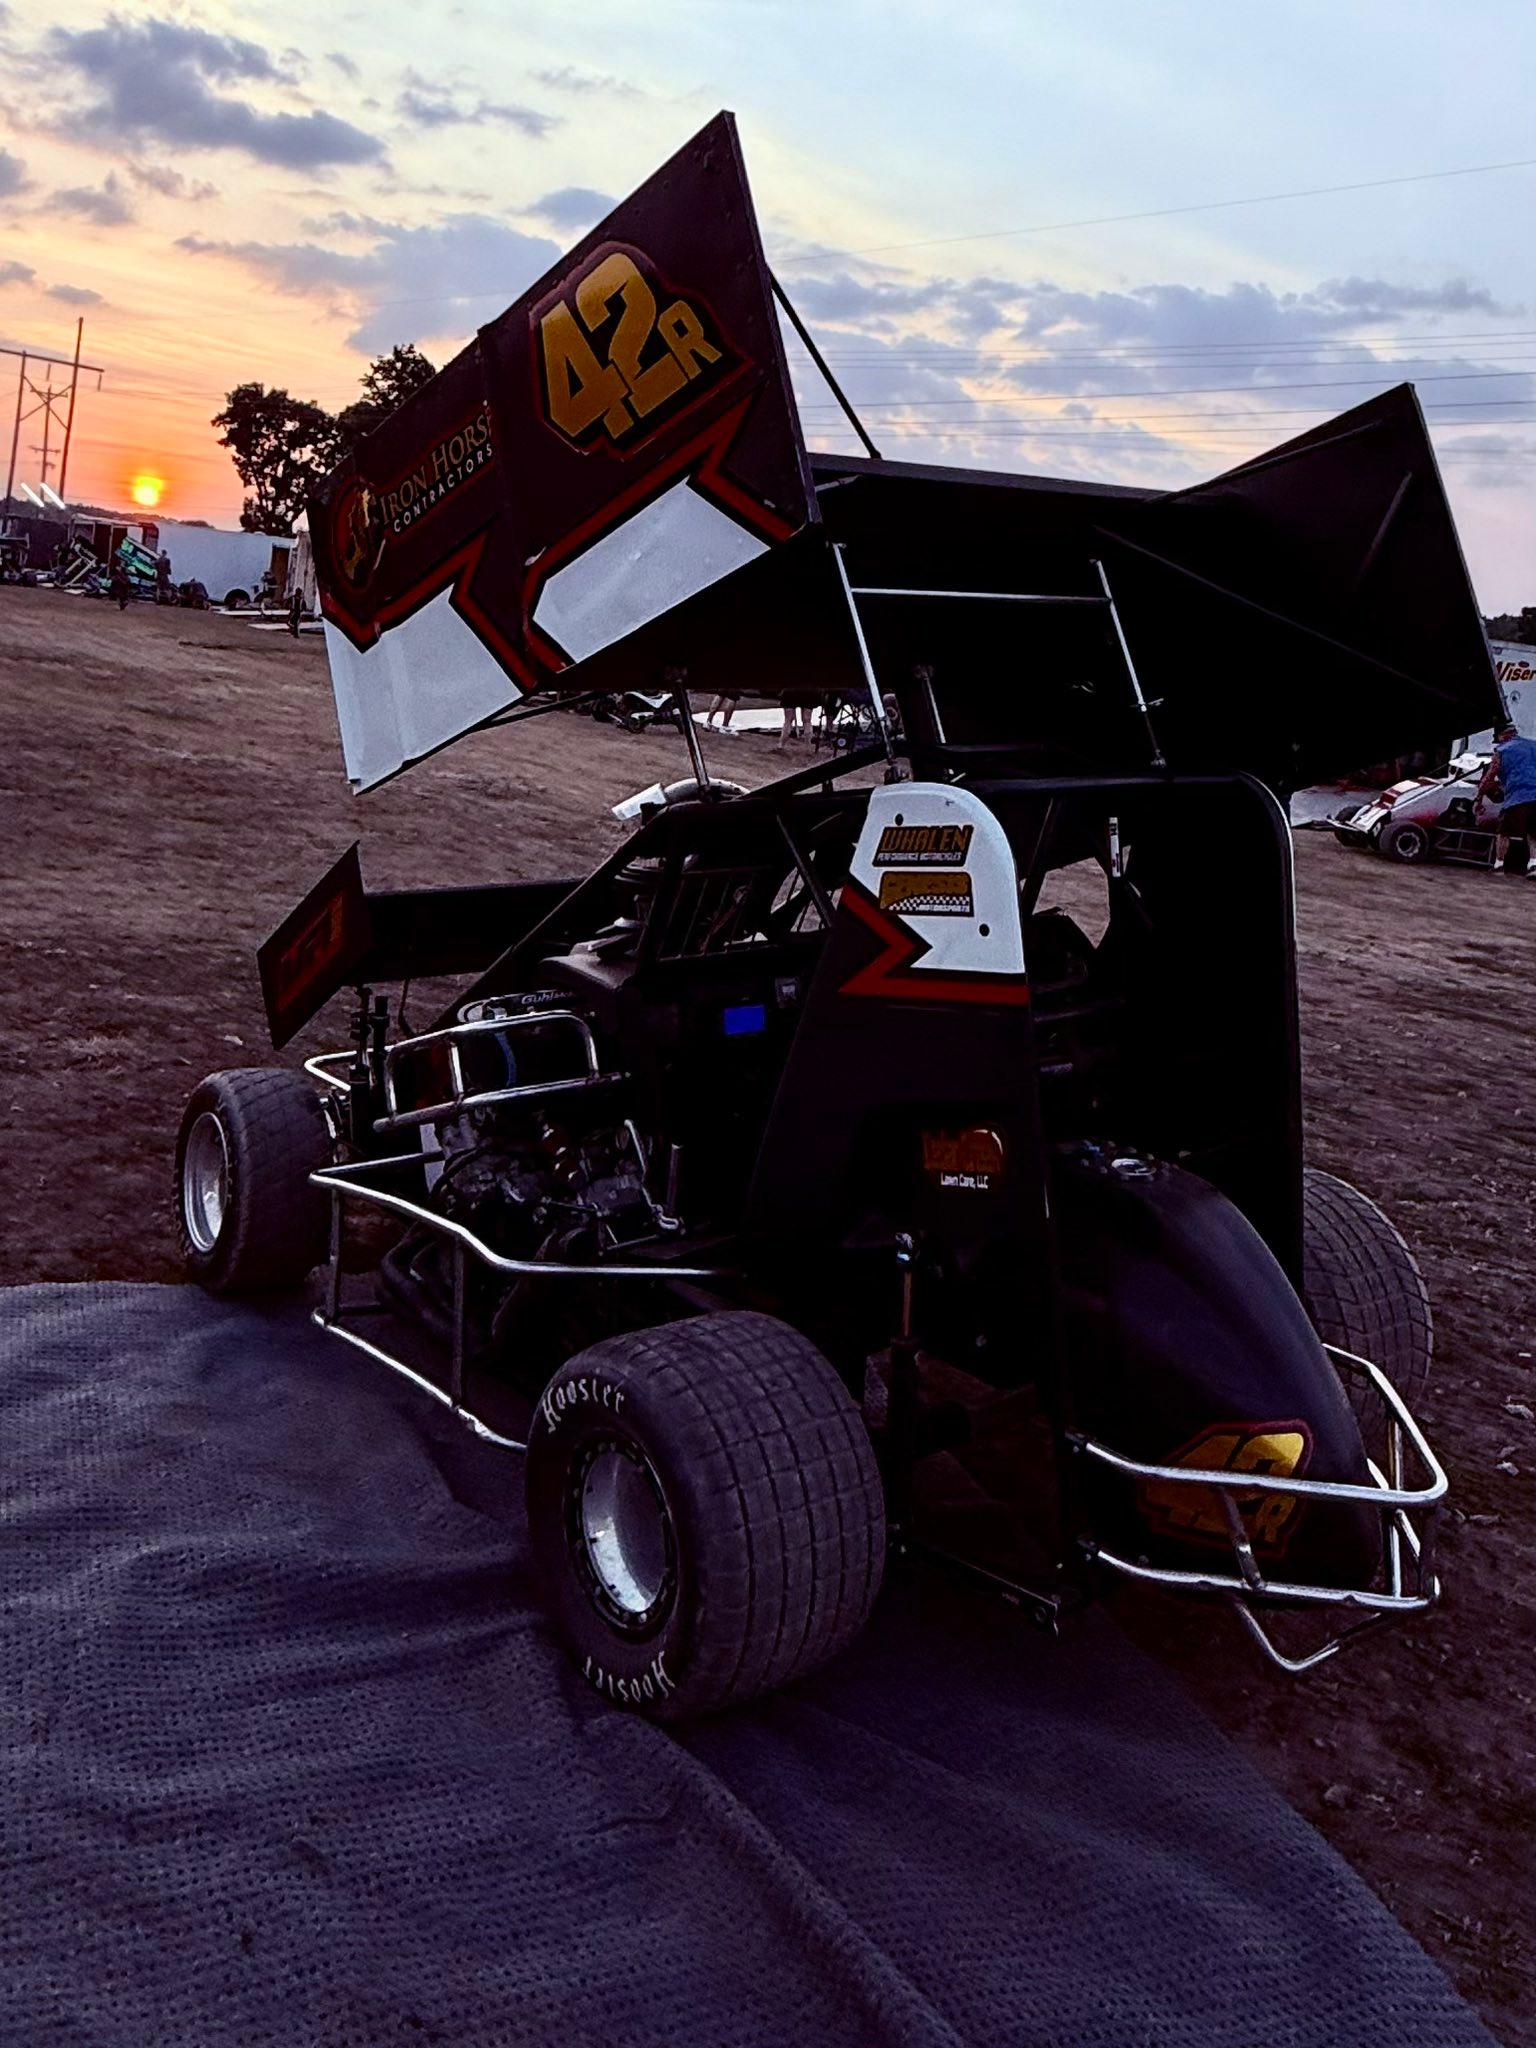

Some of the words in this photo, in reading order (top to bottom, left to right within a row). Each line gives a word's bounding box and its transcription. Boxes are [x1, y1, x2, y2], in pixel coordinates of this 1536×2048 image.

[541, 252, 722, 439] 42R
[379, 465, 428, 526] IRON
[393, 443, 493, 533] CONTRACTORS
[880, 828, 970, 852] WHALEN
[542, 1377, 625, 1434] Hoosier
